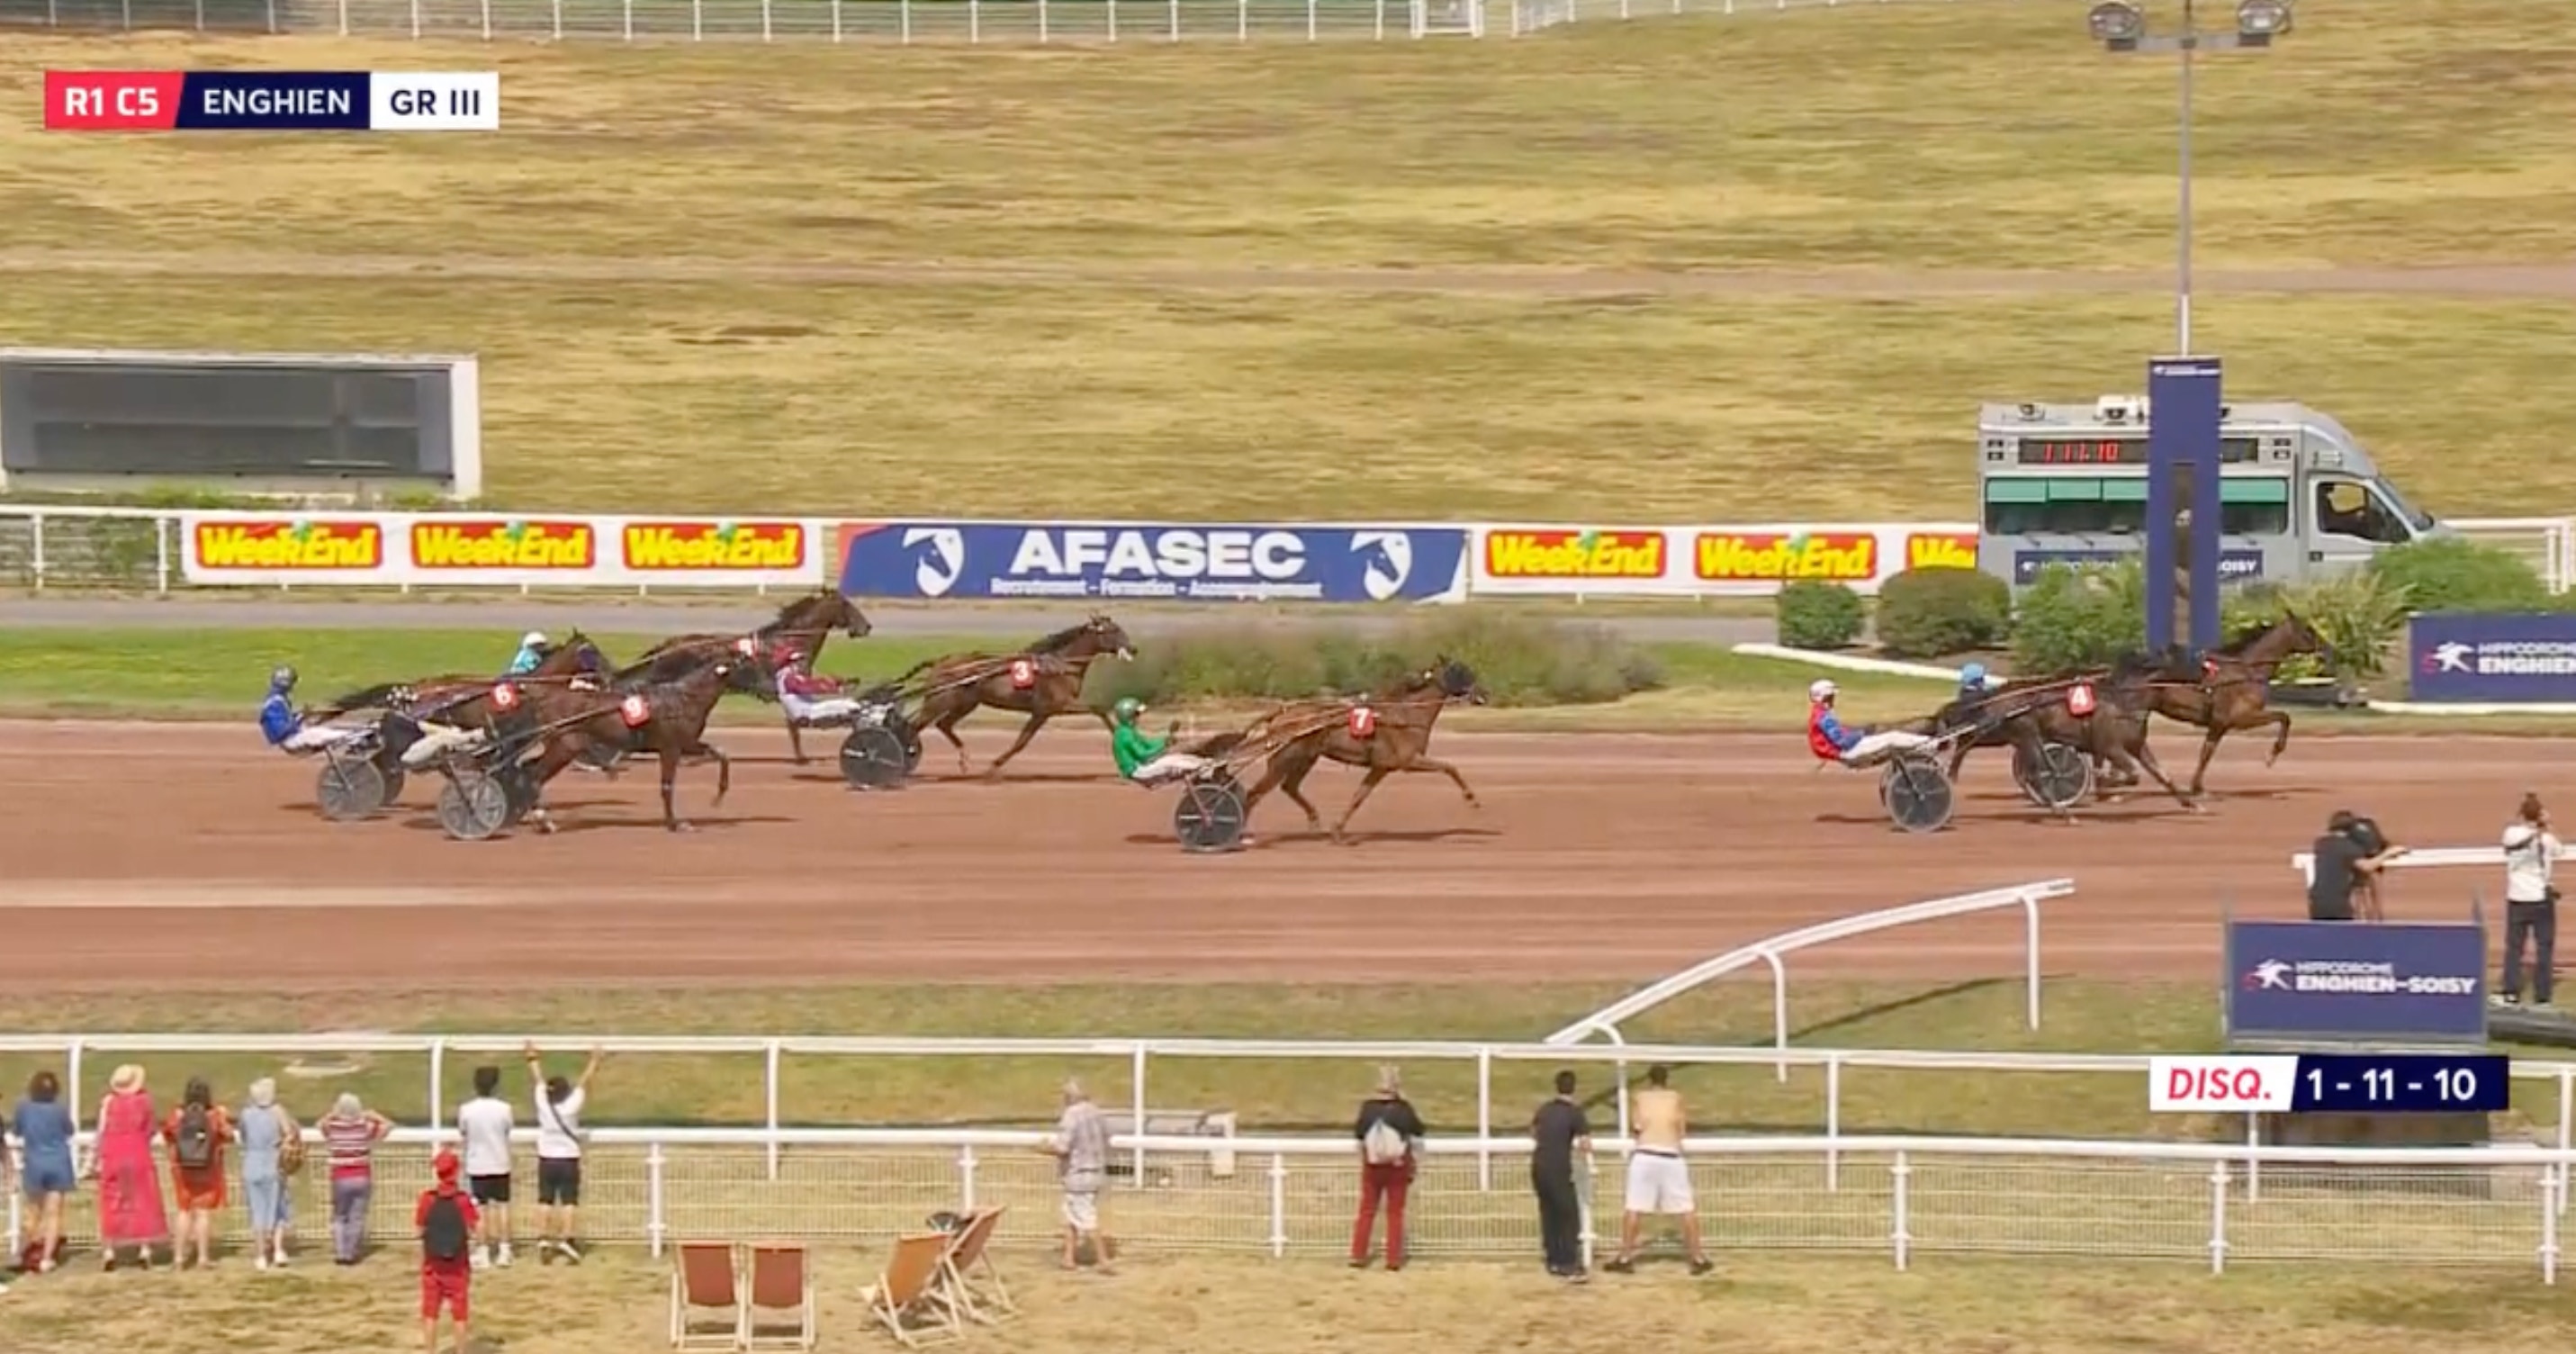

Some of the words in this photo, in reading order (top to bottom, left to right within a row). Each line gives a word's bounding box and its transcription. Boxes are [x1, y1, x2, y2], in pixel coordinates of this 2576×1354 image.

[1009, 529, 1306, 576] AFASEC
[1014, 661, 1029, 681] 3
[495, 683, 511, 705] 6
[2071, 685, 2087, 706] 4
[626, 696, 642, 718] 9
[1353, 708, 1369, 729] 7
[2295, 974, 2477, 994] ENGHIEN-SOISY
